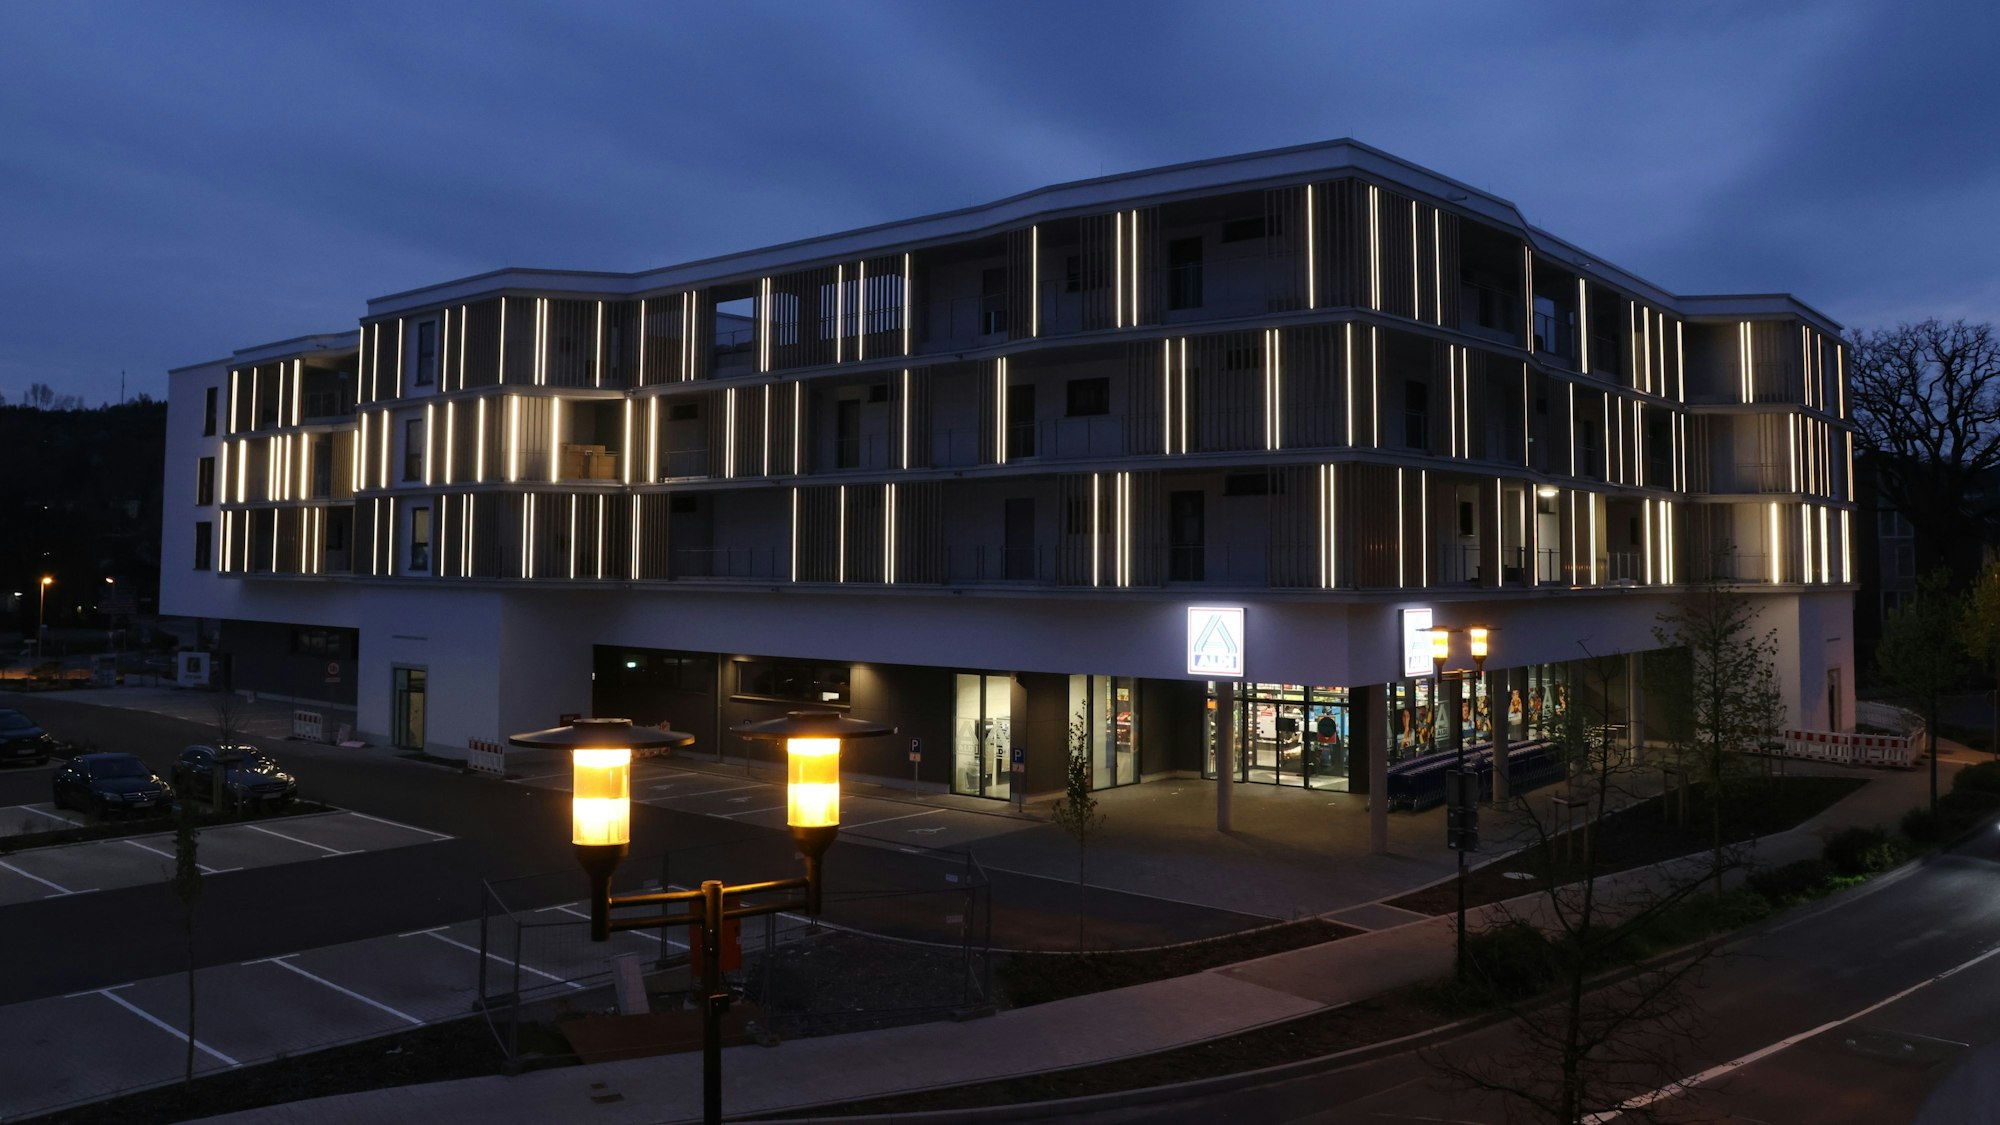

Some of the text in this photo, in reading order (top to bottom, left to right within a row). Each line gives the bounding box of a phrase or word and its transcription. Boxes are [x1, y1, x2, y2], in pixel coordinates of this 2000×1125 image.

[1196, 654, 1235, 669] ALDI
[911, 740, 919, 751] P
[1014, 749, 1022, 761] P
